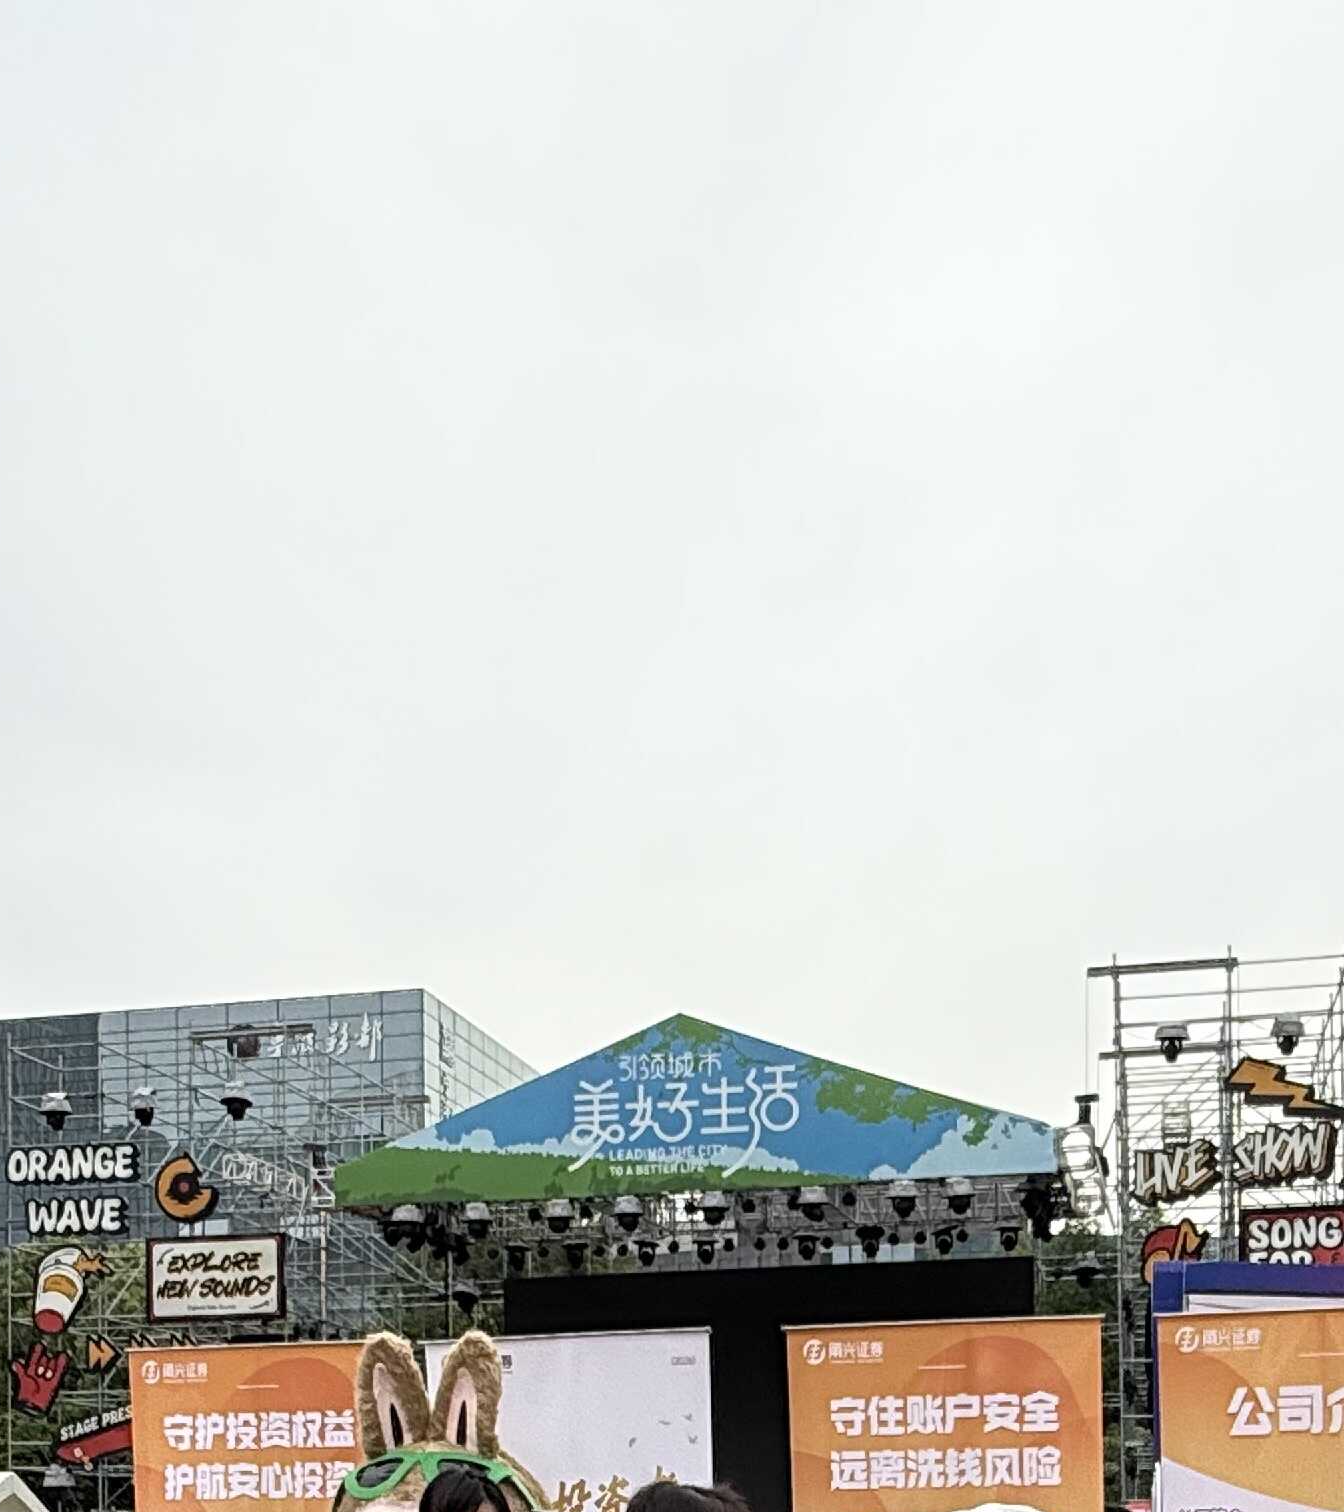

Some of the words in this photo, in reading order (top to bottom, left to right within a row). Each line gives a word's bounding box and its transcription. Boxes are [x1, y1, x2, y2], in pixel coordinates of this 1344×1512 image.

[619, 1051, 722, 1082] 引领城市
[567, 1064, 800, 1178] 美好生活
[7, 1146, 135, 1184] ORANGE
[609, 1148, 666, 1162] LEADING
[669, 1146, 695, 1160] THE
[697, 1144, 729, 1159] CITY
[609, 1165, 624, 1177] TO
[626, 1164, 634, 1176] A
[635, 1162, 677, 1176] BETTER
[678, 1160, 705, 1174] LIFE
[1135, 1139, 1216, 1200] LIVE
[1234, 1123, 1337, 1188] SHOW
[28, 1199, 124, 1233] WAVE
[1248, 1216, 1343, 1250] SONG
[167, 1251, 262, 1273] EXPLORE
[157, 1279, 199, 1299] NEW
[199, 1275, 275, 1298] SOUNDS
[61, 1416, 98, 1441] STAGE
[163, 1410, 355, 1450] 守护投资权益
[830, 1391, 1060, 1436] 守住账户安全
[164, 1462, 355, 1500] 护航安心投资
[830, 1445, 1061, 1491] 远离洗钱风险
